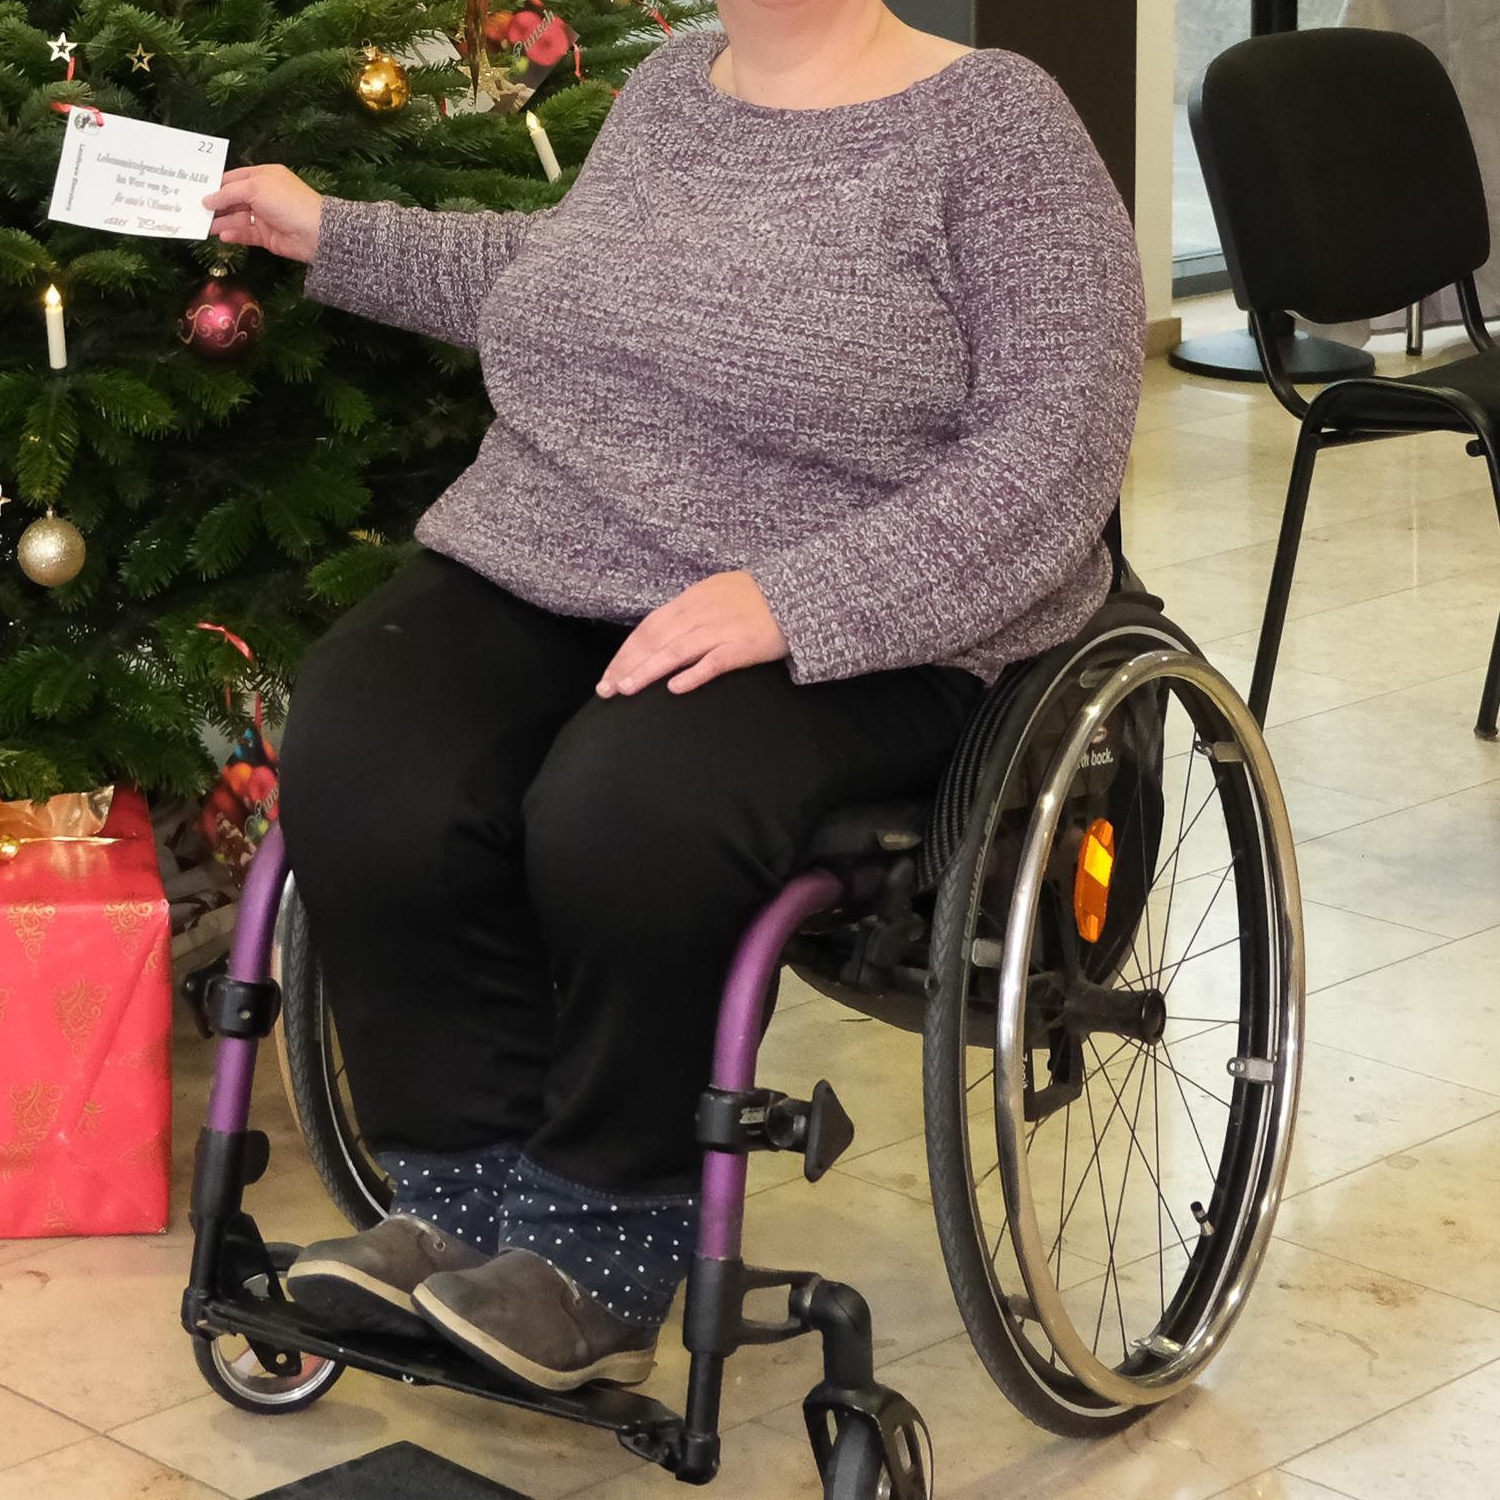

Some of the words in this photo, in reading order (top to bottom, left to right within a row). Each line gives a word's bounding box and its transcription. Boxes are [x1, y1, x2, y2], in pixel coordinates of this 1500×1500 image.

[198, 141, 213, 154] 22
[129, 176, 145, 188] Wert
[104, 217, 128, 226] aus
